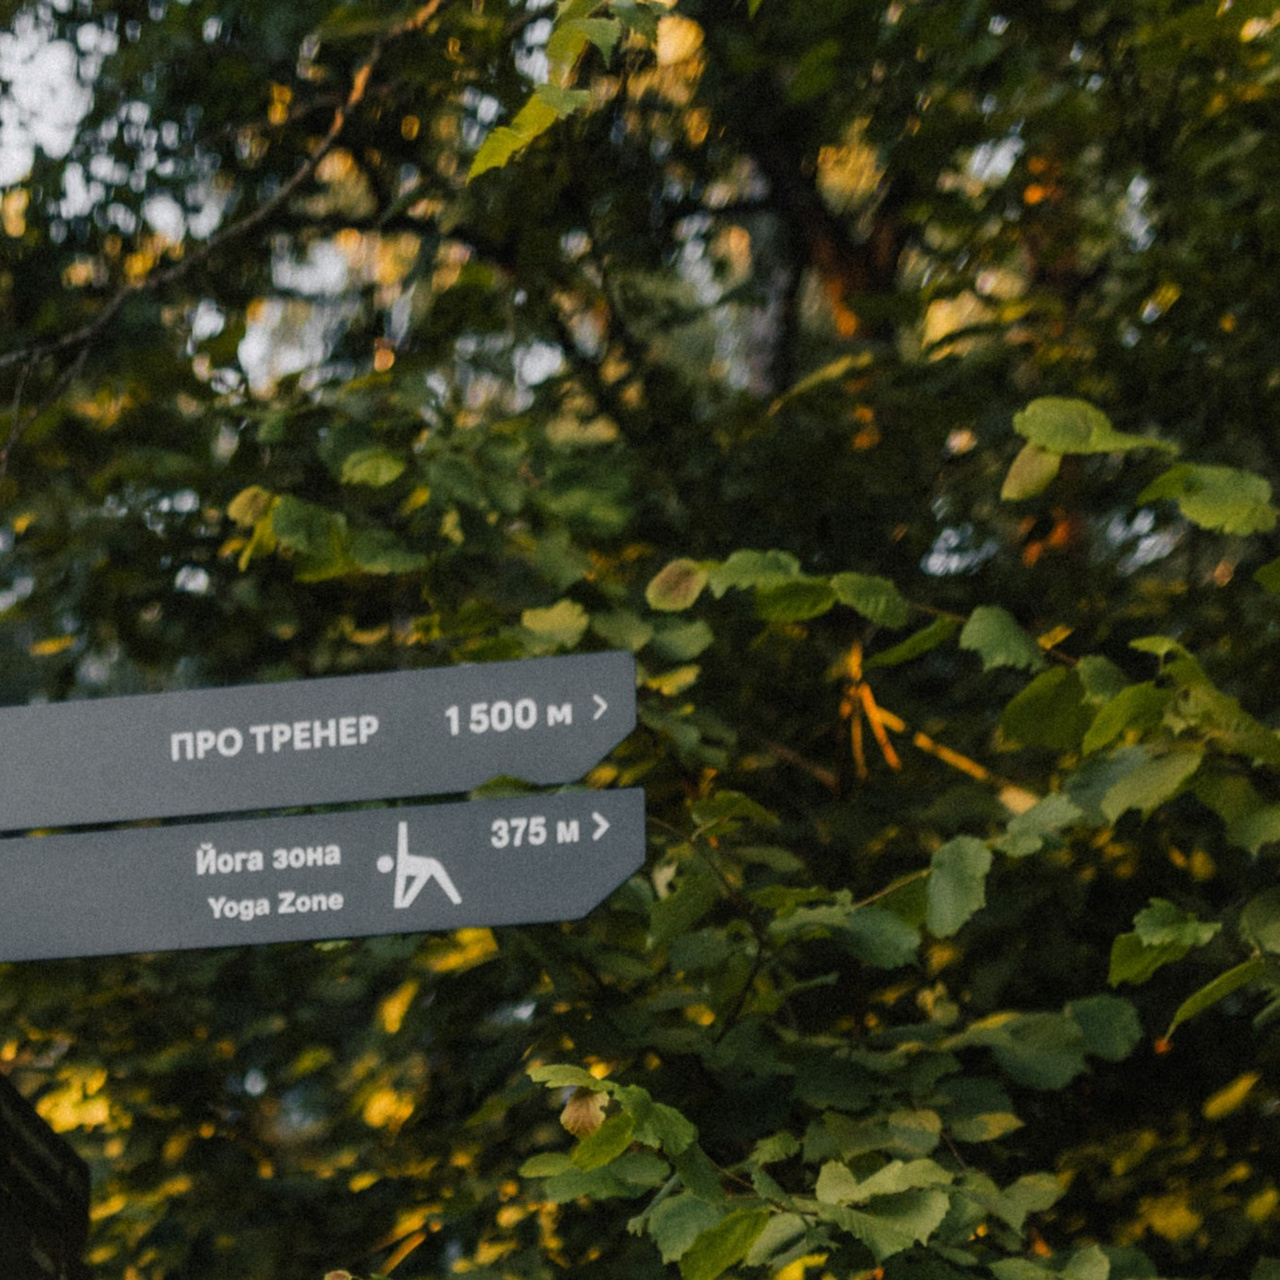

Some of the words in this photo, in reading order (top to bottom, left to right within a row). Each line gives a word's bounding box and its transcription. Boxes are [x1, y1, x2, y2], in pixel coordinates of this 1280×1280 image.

[546, 702, 573, 727] м
[170, 727, 244, 762] ПРО
[248, 714, 380, 754] ТРЕНЕР
[490, 815, 548, 850] 375
[555, 819, 581, 844] м
[195, 842, 265, 876] Йога
[272, 843, 342, 871] зона
[206, 895, 271, 922] Yoga
[277, 890, 345, 915] Zone
